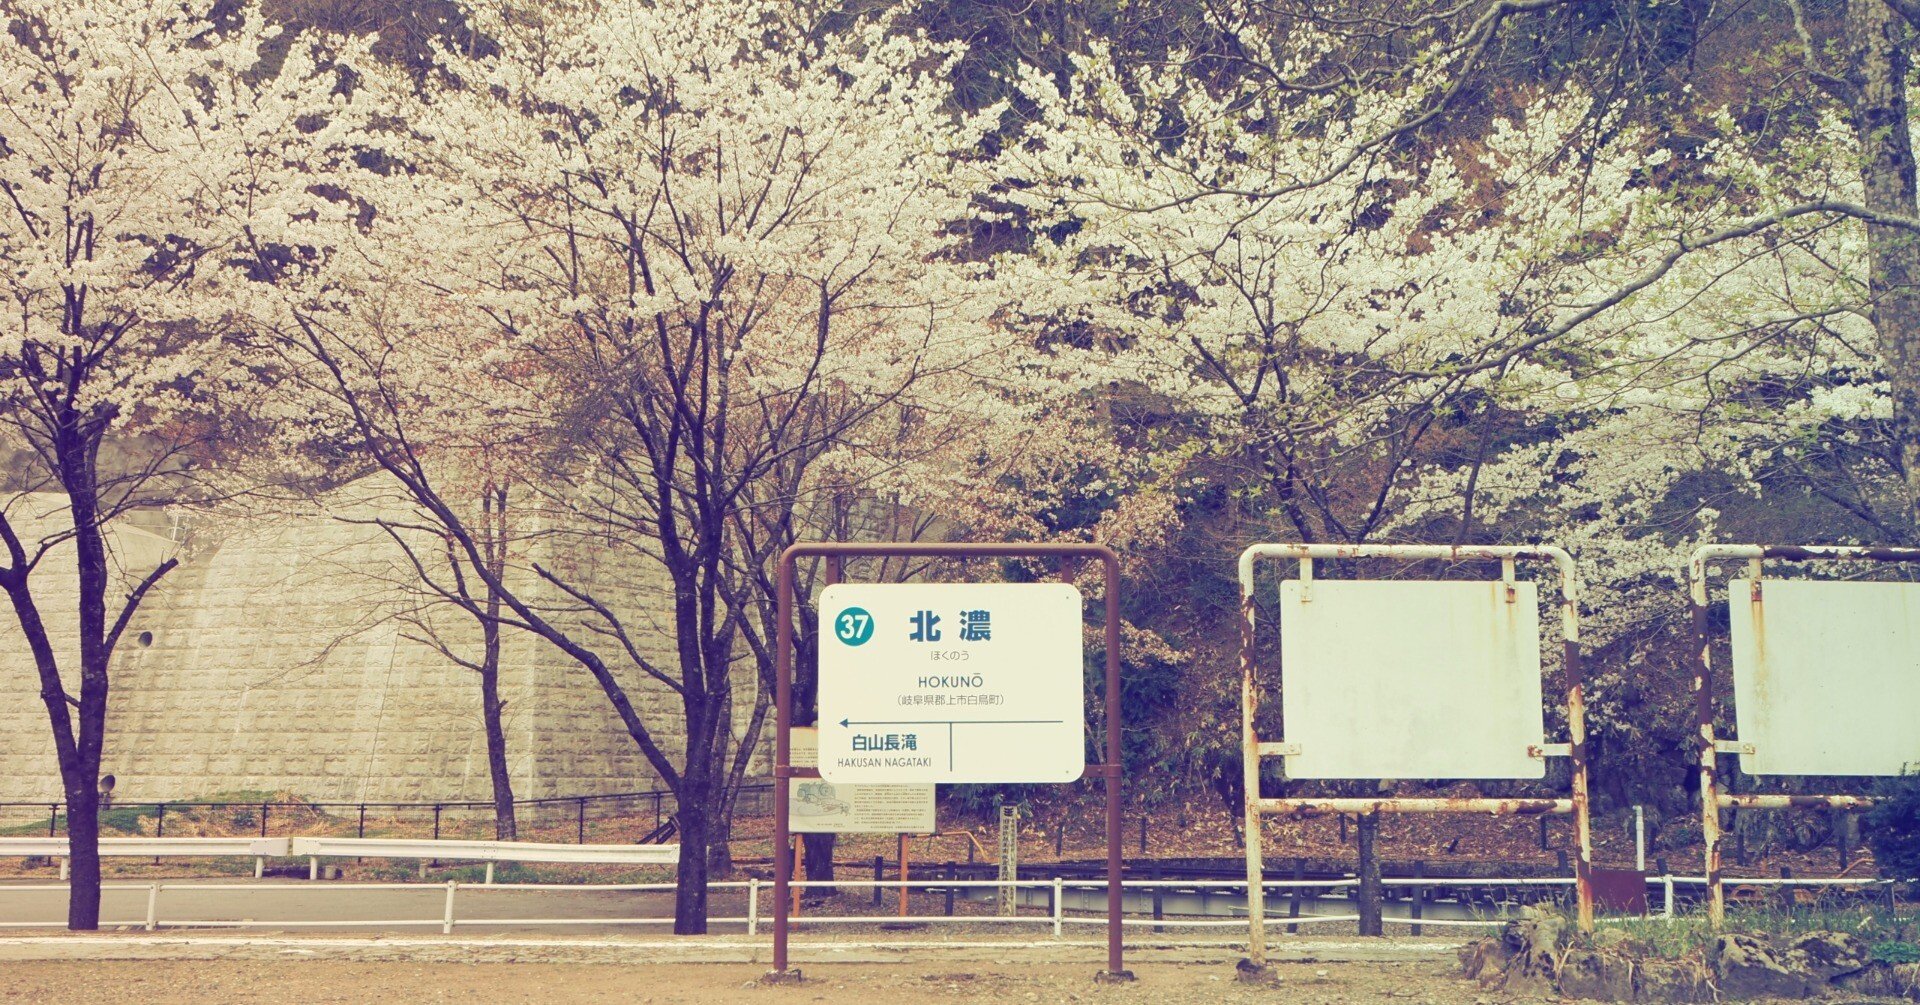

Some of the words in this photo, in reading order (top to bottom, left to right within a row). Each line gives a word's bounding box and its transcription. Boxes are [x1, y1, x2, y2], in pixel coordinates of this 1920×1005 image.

[841, 615, 869, 639] 37
[909, 610, 991, 642] 北濃
[930, 650, 970, 661] ほくのう
[918, 672, 984, 688] HOKUNŌ
[852, 734, 917, 751] 白山長滝
[837, 757, 882, 768] HAKUSAN
[884, 757, 932, 768] NAGATAKI
